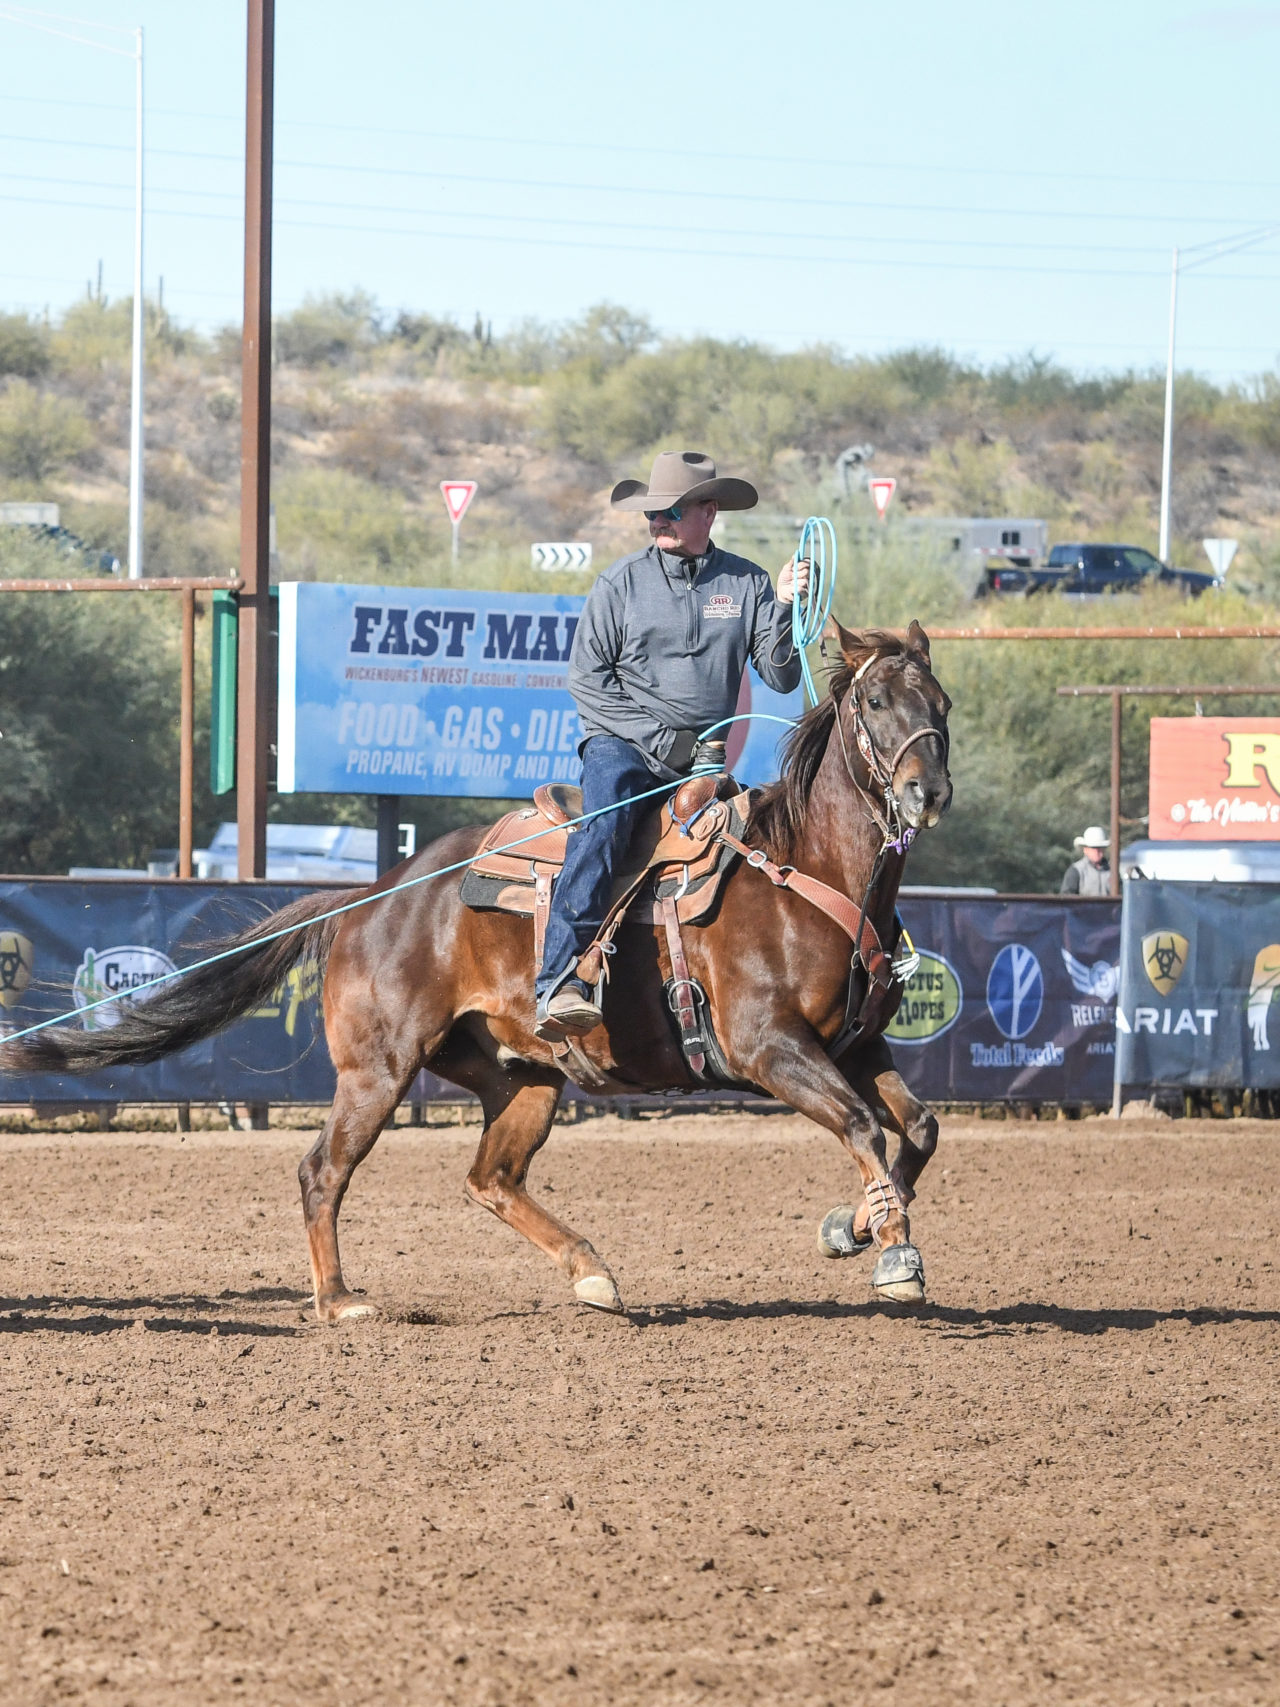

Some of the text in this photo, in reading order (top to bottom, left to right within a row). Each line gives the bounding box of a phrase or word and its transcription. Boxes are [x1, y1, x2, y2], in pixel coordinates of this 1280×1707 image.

[349, 606, 580, 662] FAST MA
[345, 667, 419, 683] WICKENBURG'S
[421, 668, 470, 685] NEWEST
[471, 671, 517, 687] GASOLINE
[337, 702, 582, 753] FOOD GAS DIE
[346, 750, 583, 780] PROPANE, RV DUMP AND MO
[971, 1041, 1065, 1067] Total Feeds
